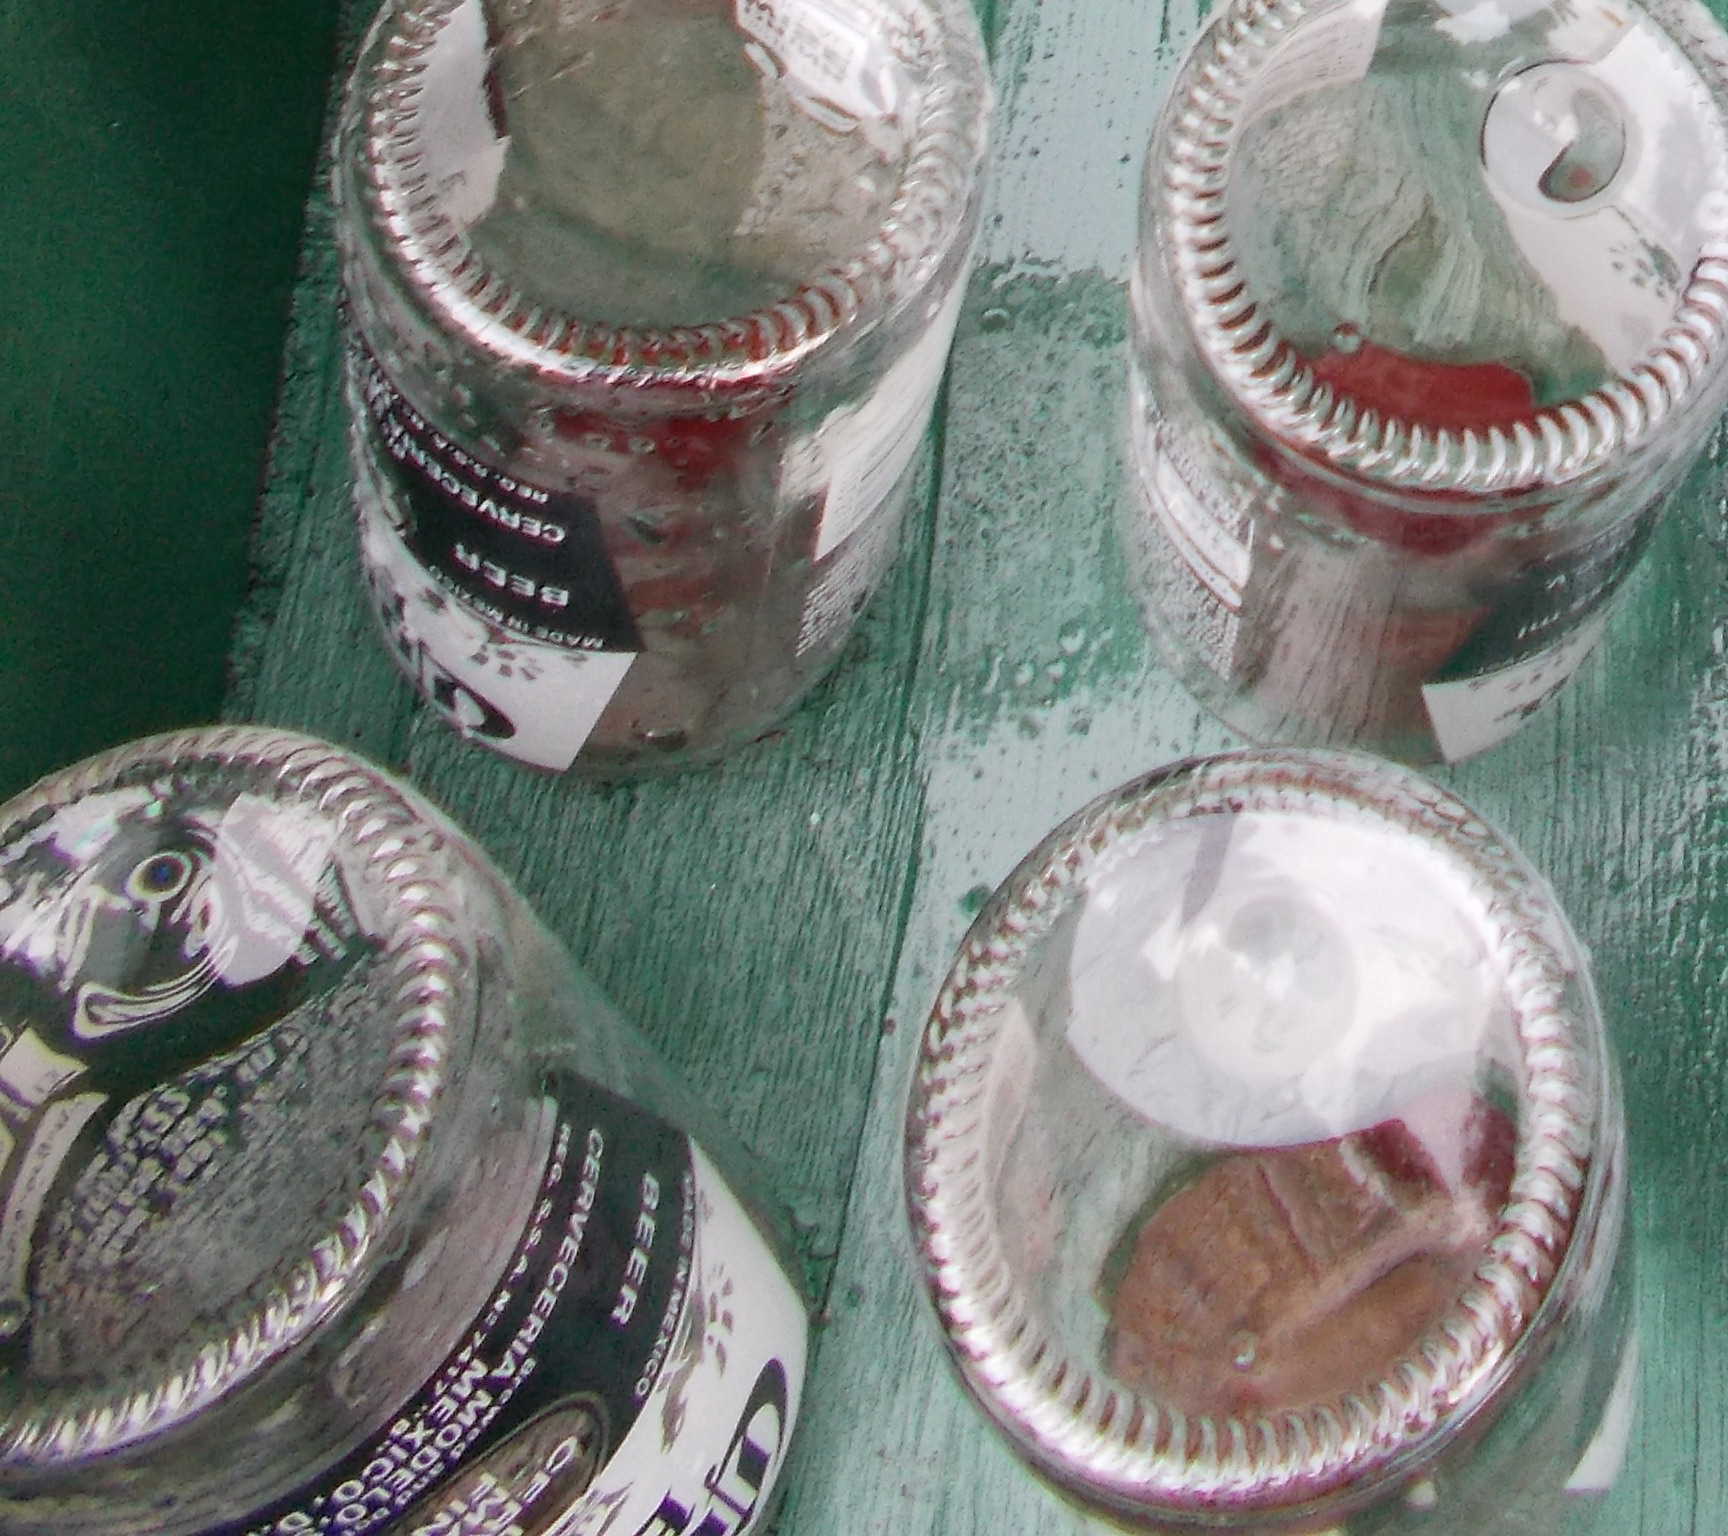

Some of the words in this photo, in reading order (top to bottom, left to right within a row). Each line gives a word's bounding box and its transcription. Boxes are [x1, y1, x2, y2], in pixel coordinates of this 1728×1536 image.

[455, 544, 569, 607] BEER
[493, 1128, 604, 1380] CERVECERIA
[610, 1172, 660, 1328] BEER
